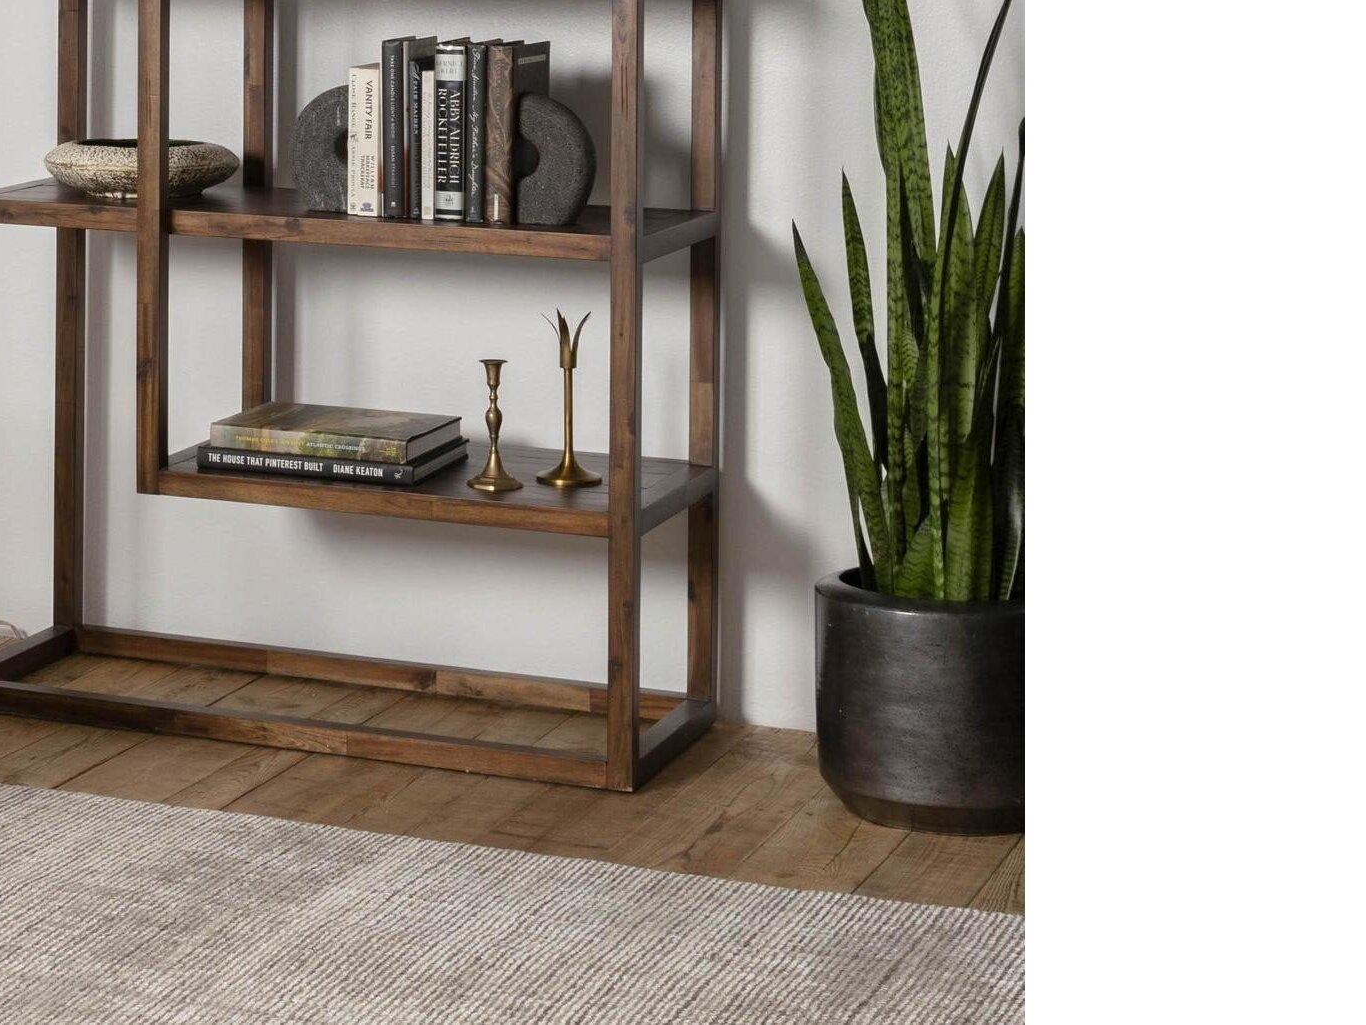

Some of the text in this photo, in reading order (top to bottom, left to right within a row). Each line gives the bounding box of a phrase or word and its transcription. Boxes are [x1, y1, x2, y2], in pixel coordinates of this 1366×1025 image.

[364, 80, 373, 139] VANITY FAIR
[438, 88, 447, 183] ROCKEFELLER
[449, 89, 461, 124] ABBY
[449, 126, 460, 184] ALDRICH
[208, 453, 383, 477] THE HOUSE THAT PINTEREST BUILT DIANE KEATON
